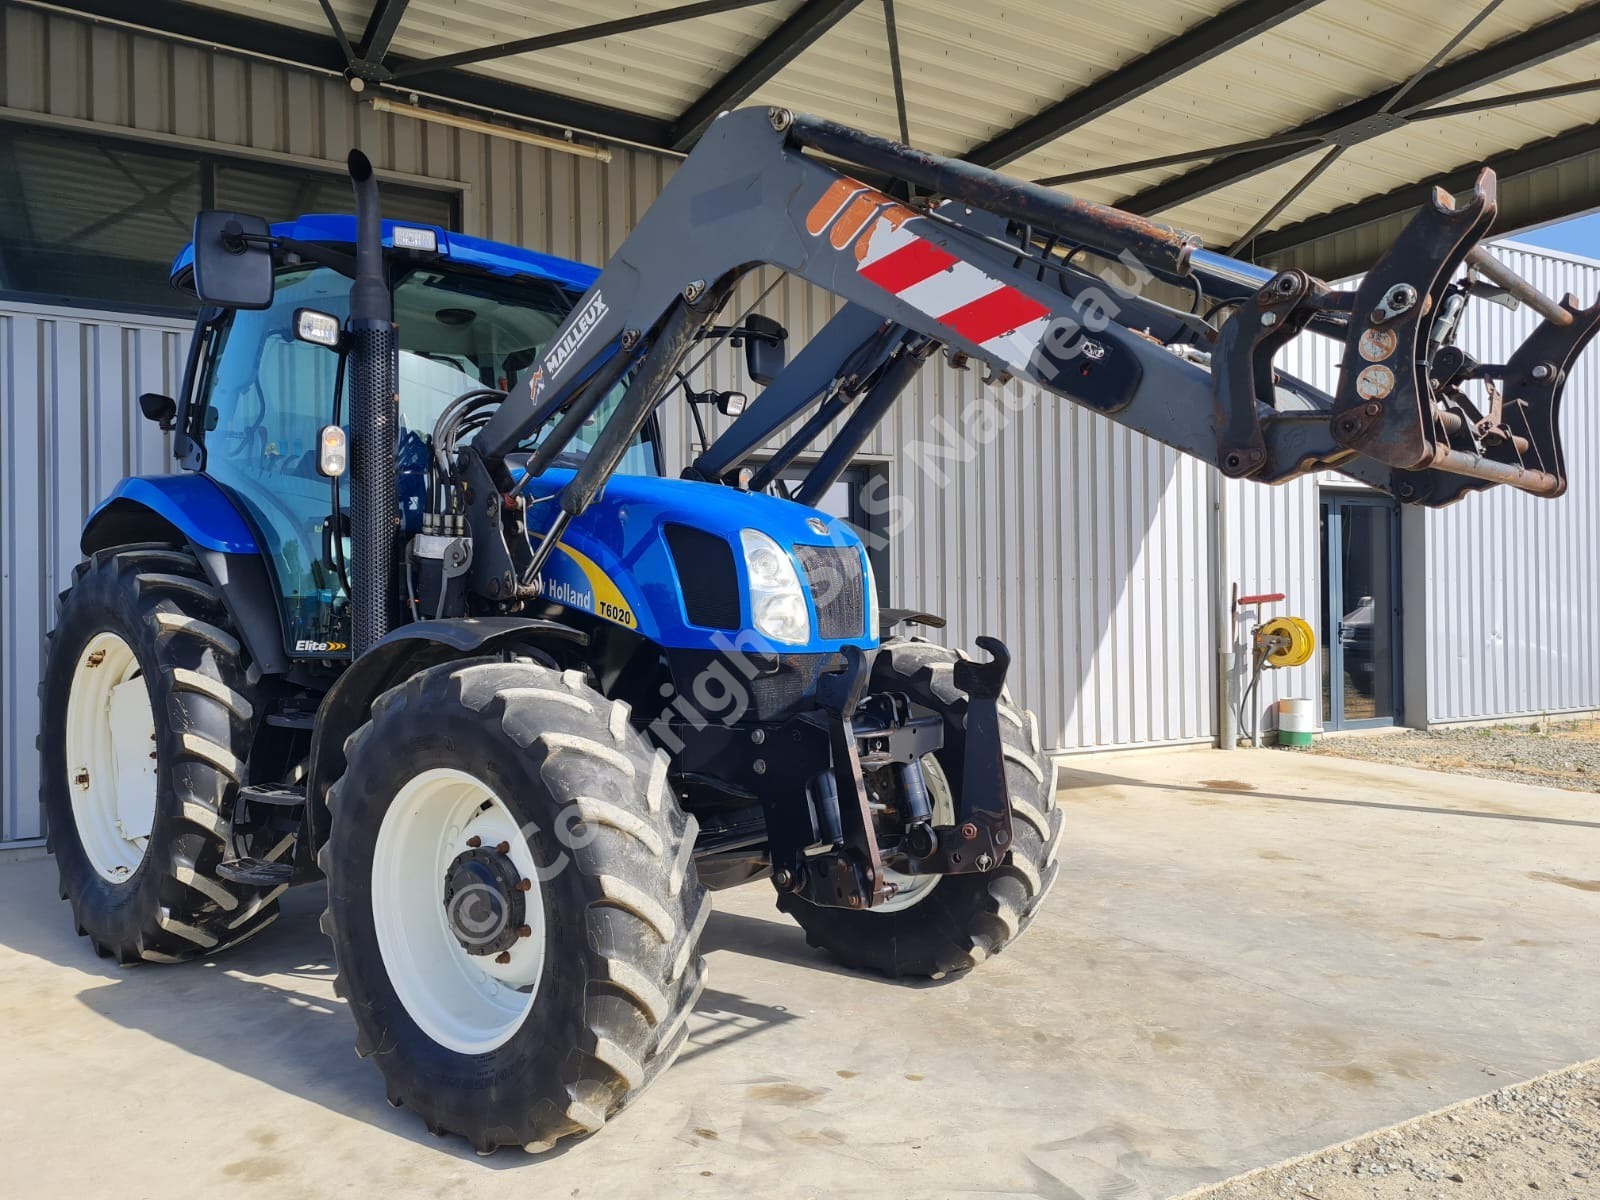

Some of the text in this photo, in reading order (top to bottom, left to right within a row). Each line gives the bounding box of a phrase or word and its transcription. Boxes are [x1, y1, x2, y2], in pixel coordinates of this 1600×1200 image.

[546, 294, 607, 374] MAILLEUX
[549, 578, 591, 609] Holland
[600, 602, 631, 625] T6020
[295, 640, 328, 651] Elite
